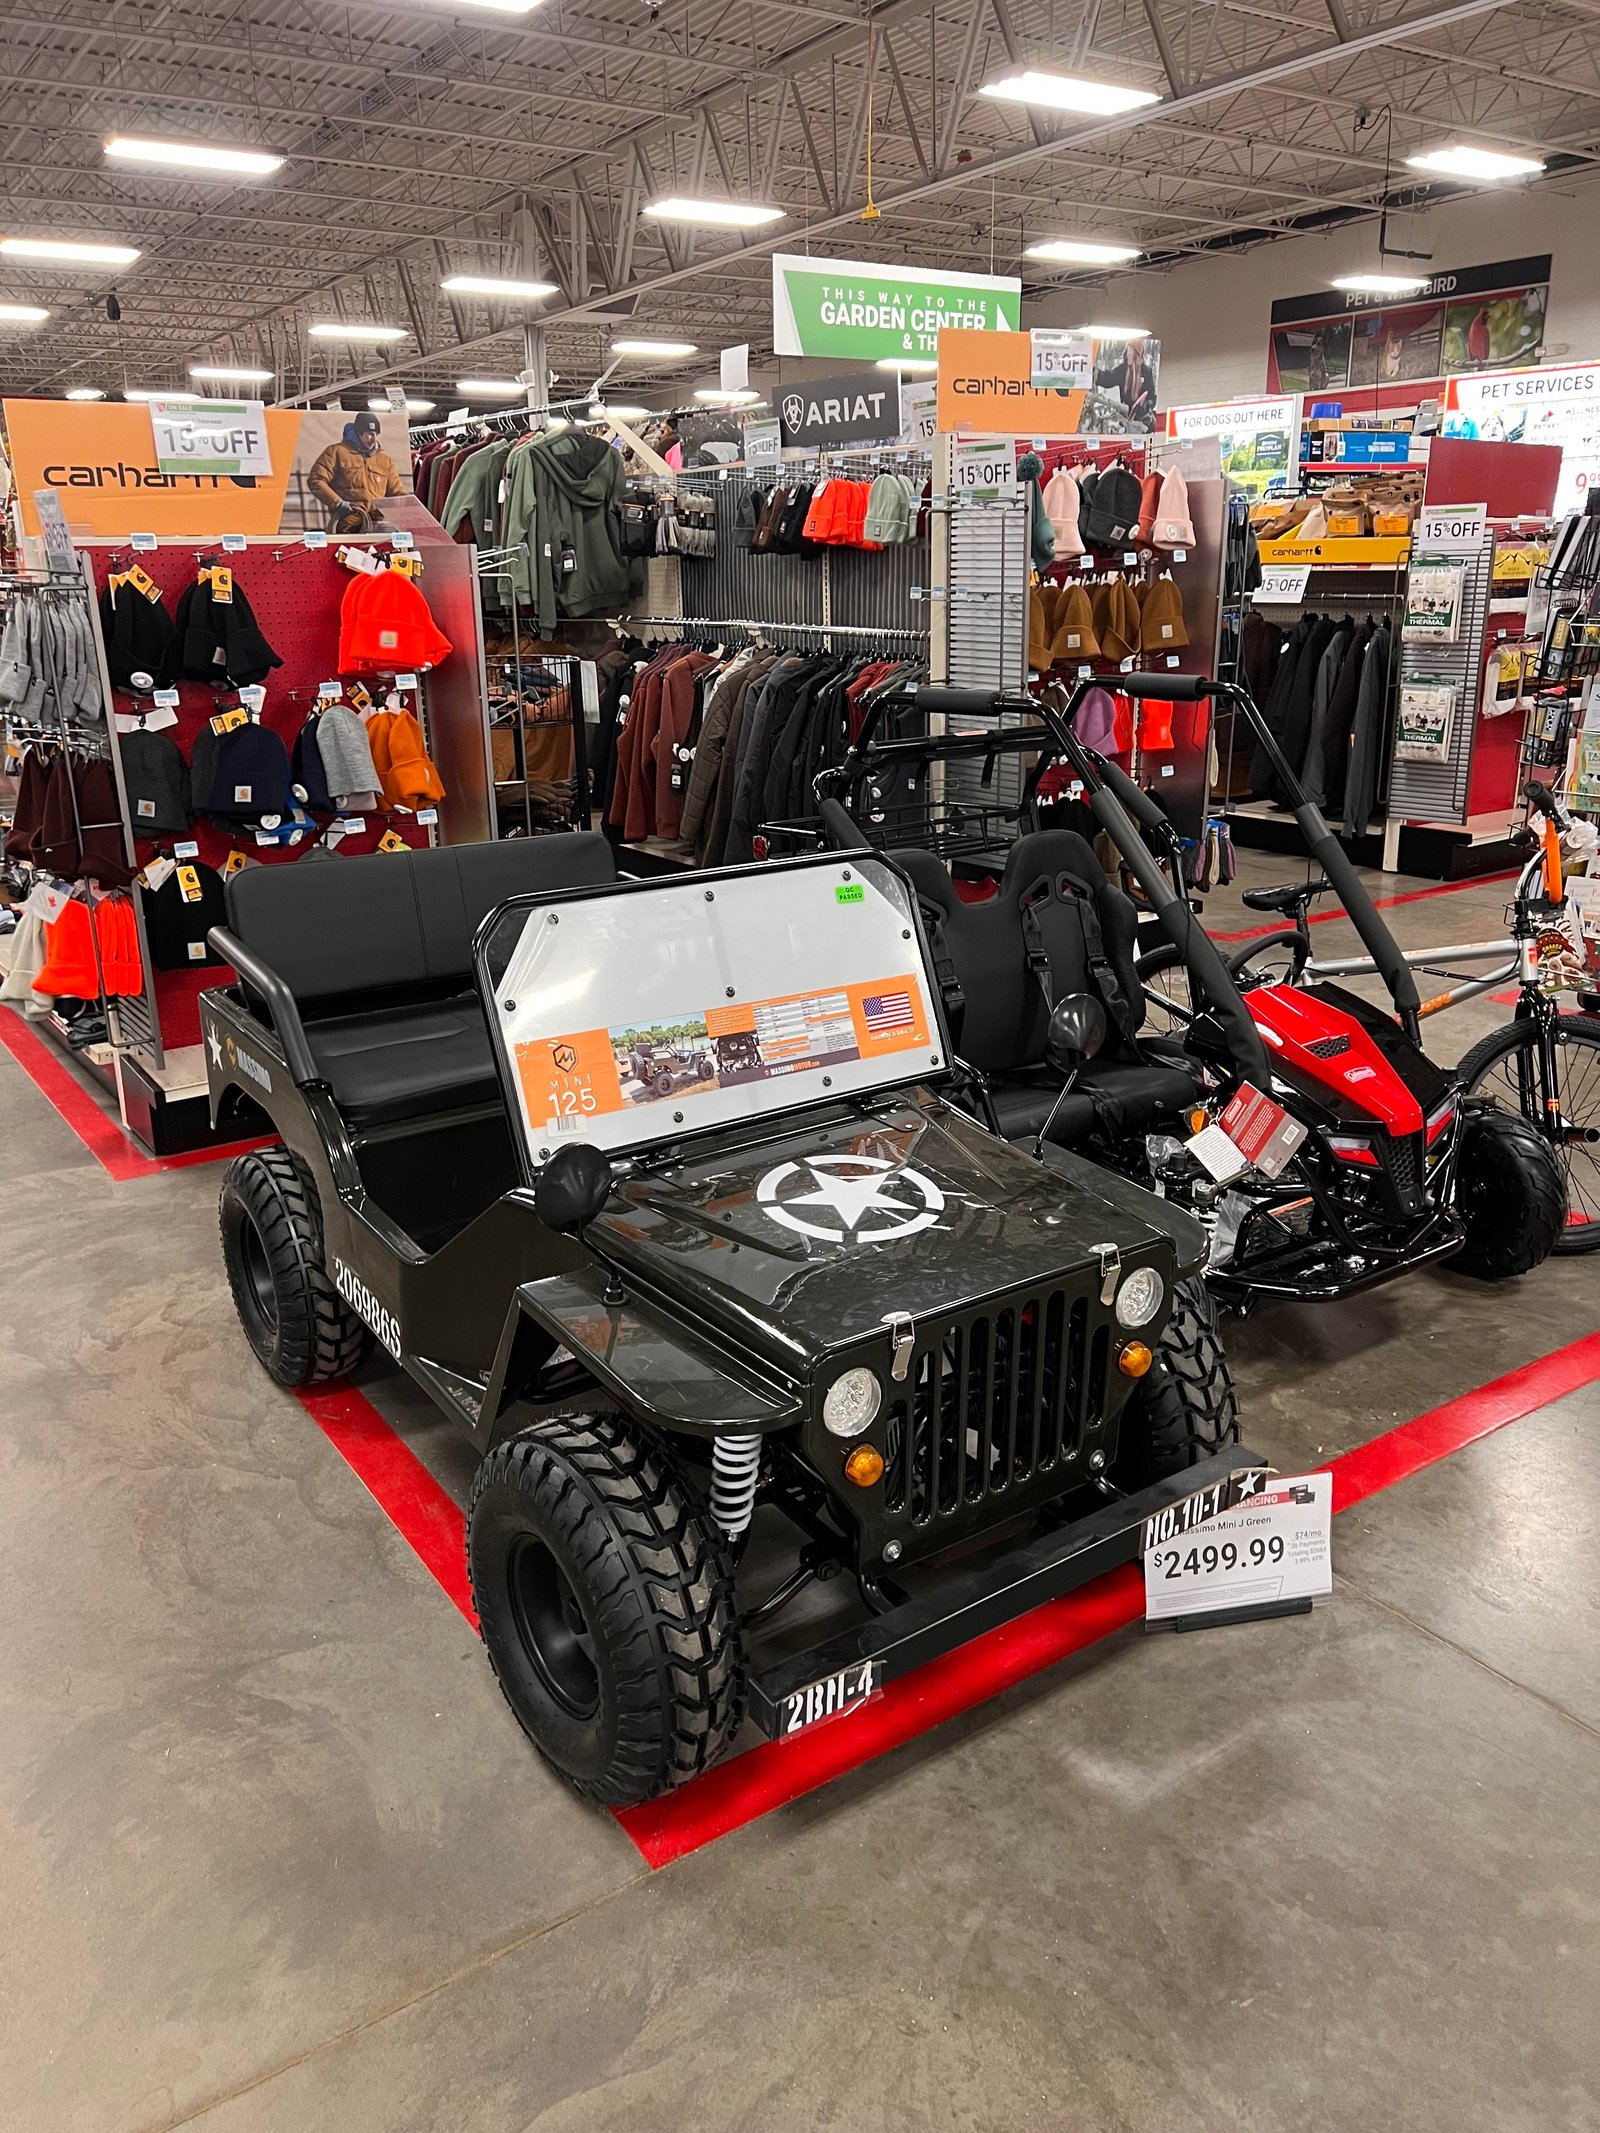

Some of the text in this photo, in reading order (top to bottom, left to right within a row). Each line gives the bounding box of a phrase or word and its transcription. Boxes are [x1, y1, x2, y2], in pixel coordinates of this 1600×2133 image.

[1423, 275, 1457, 295] BIRD
[822, 287, 987, 312] THIS WAY TO THE
[820, 301, 986, 332] GARDEN CENTER
[902, 333, 913, 351] &
[1481, 375, 1595, 398] PET SERVICES
[806, 392, 886, 427] ARIAT
[1183, 408, 1285, 428] FOR DOGS OUT HERE
[1271, 546, 1314, 556] carhartt
[1404, 734, 1437, 742] THERMAL
[839, 892, 863, 901] PASSED
[550, 1072, 593, 1091] MINI
[548, 1087, 598, 1118] 125
[1217, 1520, 1237, 1531] Mini
[1238, 1519, 1245, 1528] J
[1246, 1516, 1272, 1527] Green
[1295, 1530, 1322, 1540] $74/mo
[1154, 1535, 1285, 1580] $2499.99
